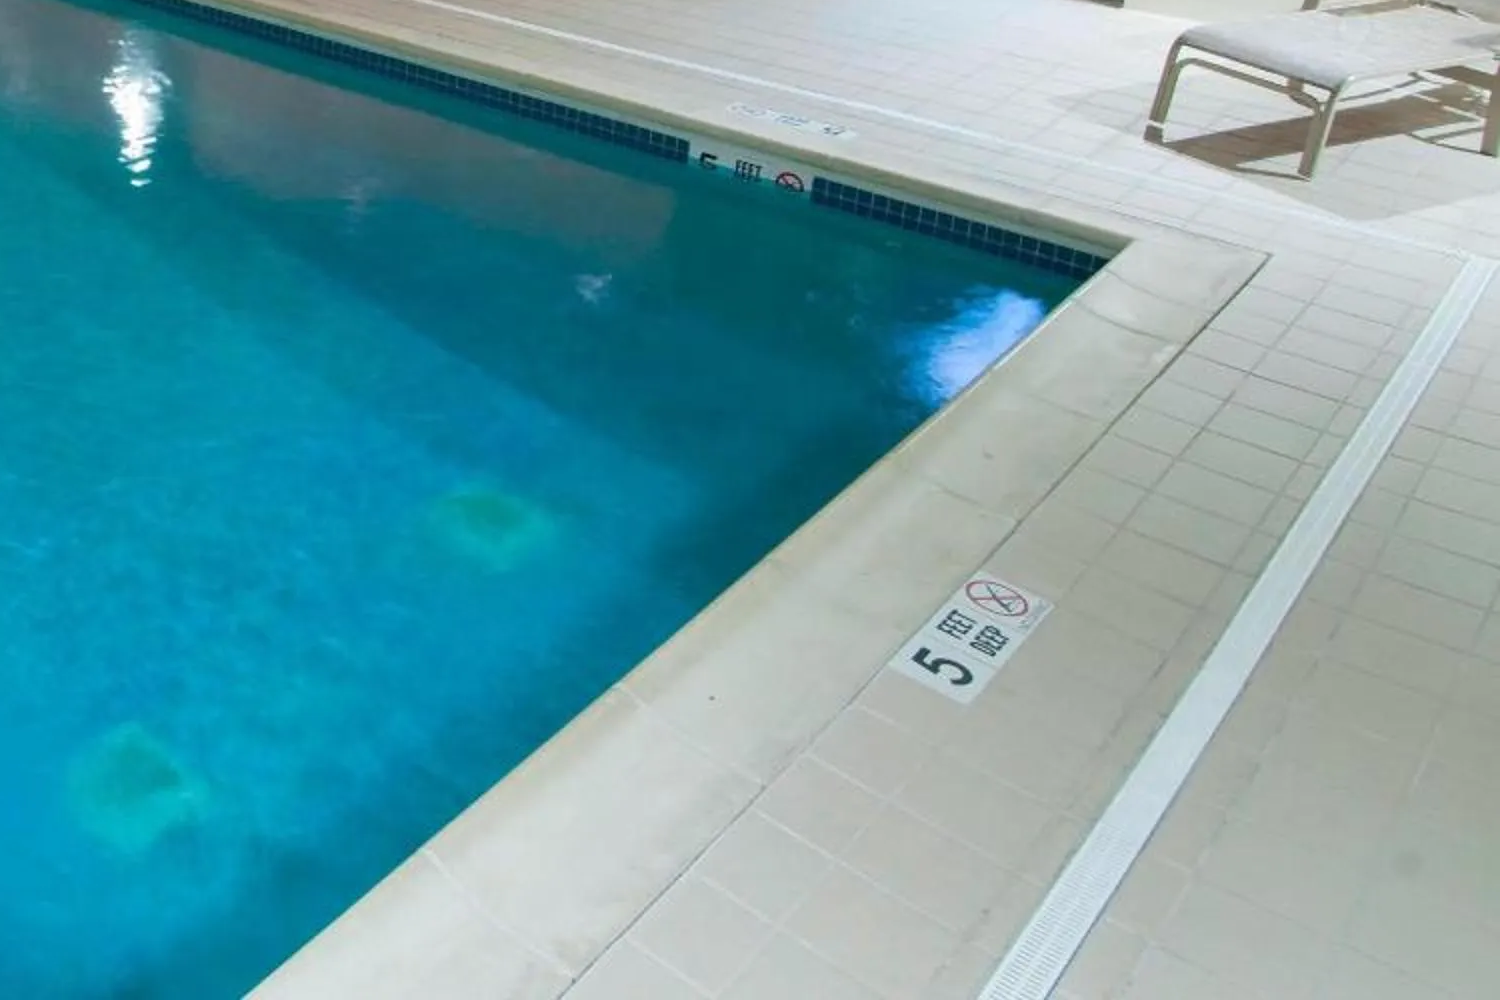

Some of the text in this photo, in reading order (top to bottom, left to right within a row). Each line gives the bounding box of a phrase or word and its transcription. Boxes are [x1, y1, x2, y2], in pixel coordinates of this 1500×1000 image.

[936, 609, 978, 641] FEET
[969, 625, 1010, 657] DEEP
[911, 647, 974, 686] 5
